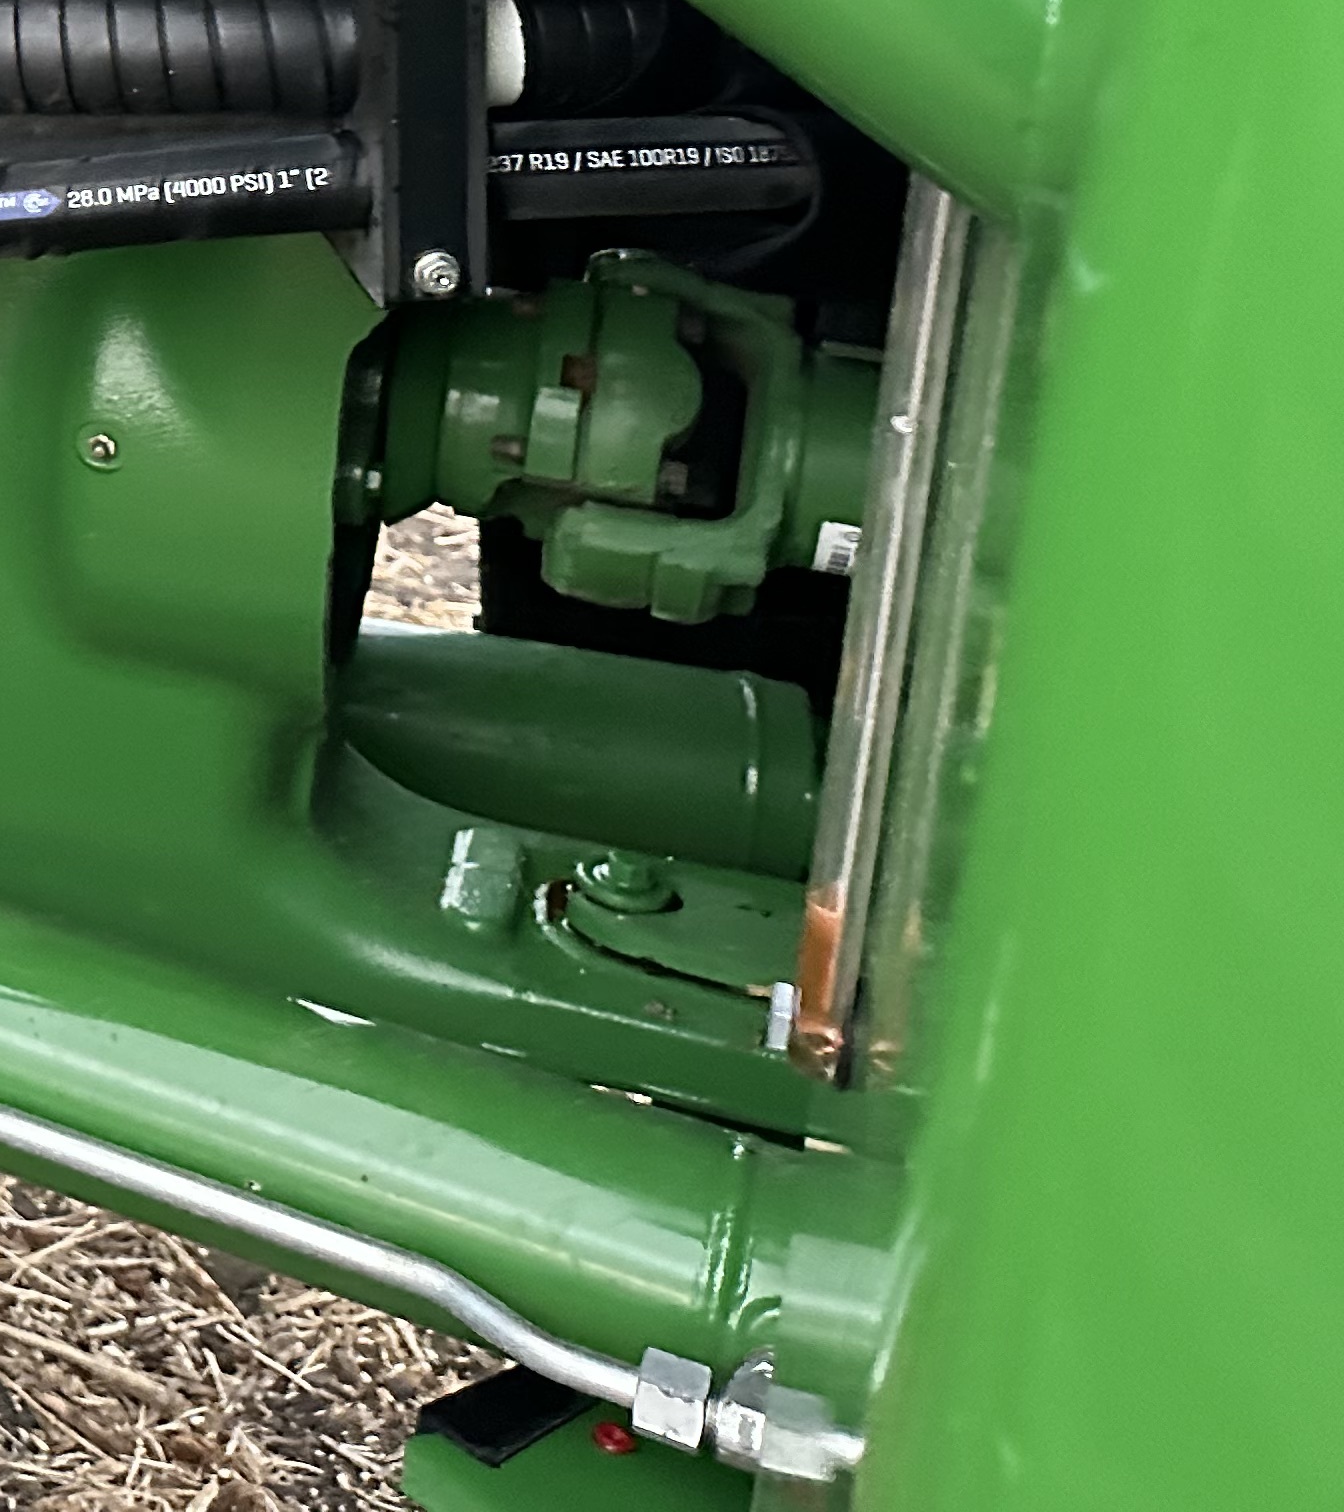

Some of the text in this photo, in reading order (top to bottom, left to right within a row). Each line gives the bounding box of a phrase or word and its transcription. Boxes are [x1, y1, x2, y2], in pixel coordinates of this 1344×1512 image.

[529, 152, 569, 171] R19
[587, 149, 626, 169] SAE
[627, 147, 700, 168] 100R19
[66, 188, 112, 209] 28.0
[116, 183, 160, 203] MPa
[163, 178, 226, 204] (4000
[231, 171, 274, 195] PSI)
